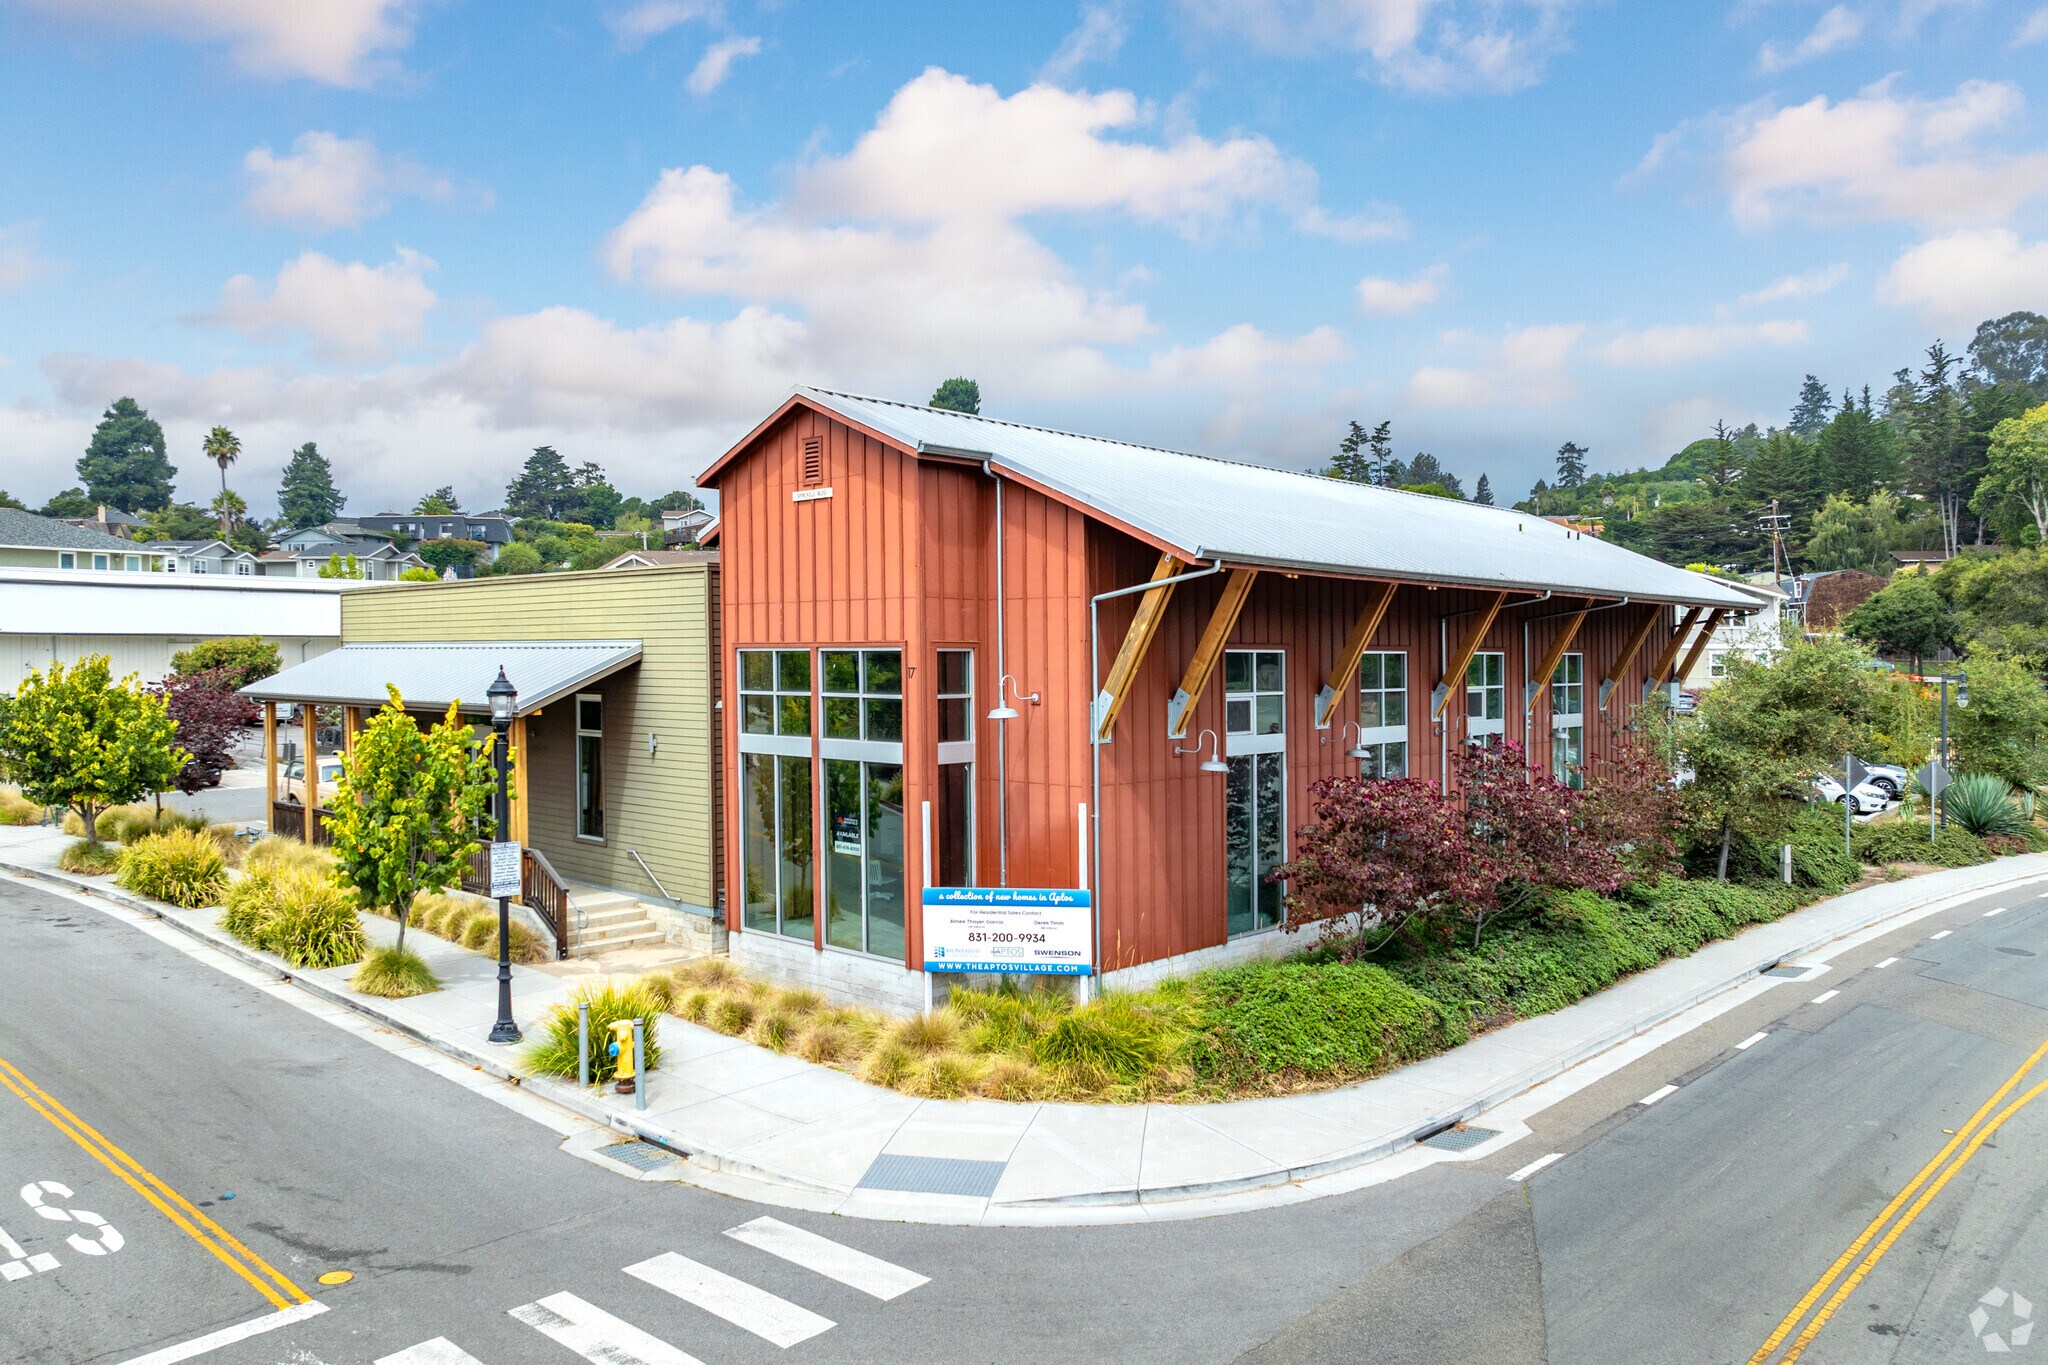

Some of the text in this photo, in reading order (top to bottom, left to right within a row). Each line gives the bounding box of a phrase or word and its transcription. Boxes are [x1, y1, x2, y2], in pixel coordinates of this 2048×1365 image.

[907, 667, 917, 679] 17
[945, 890, 983, 900] collection
[985, 890, 994, 903] of
[1012, 891, 1038, 901] homes
[1039, 893, 1047, 901] in
[1048, 892, 1074, 905] Aptos
[968, 932, 1046, 943] 831-200-9934
[1034, 949, 1081, 957] SWENSON
[938, 962, 1078, 973] WWW.THEAPTOSVILLAGE.COM
